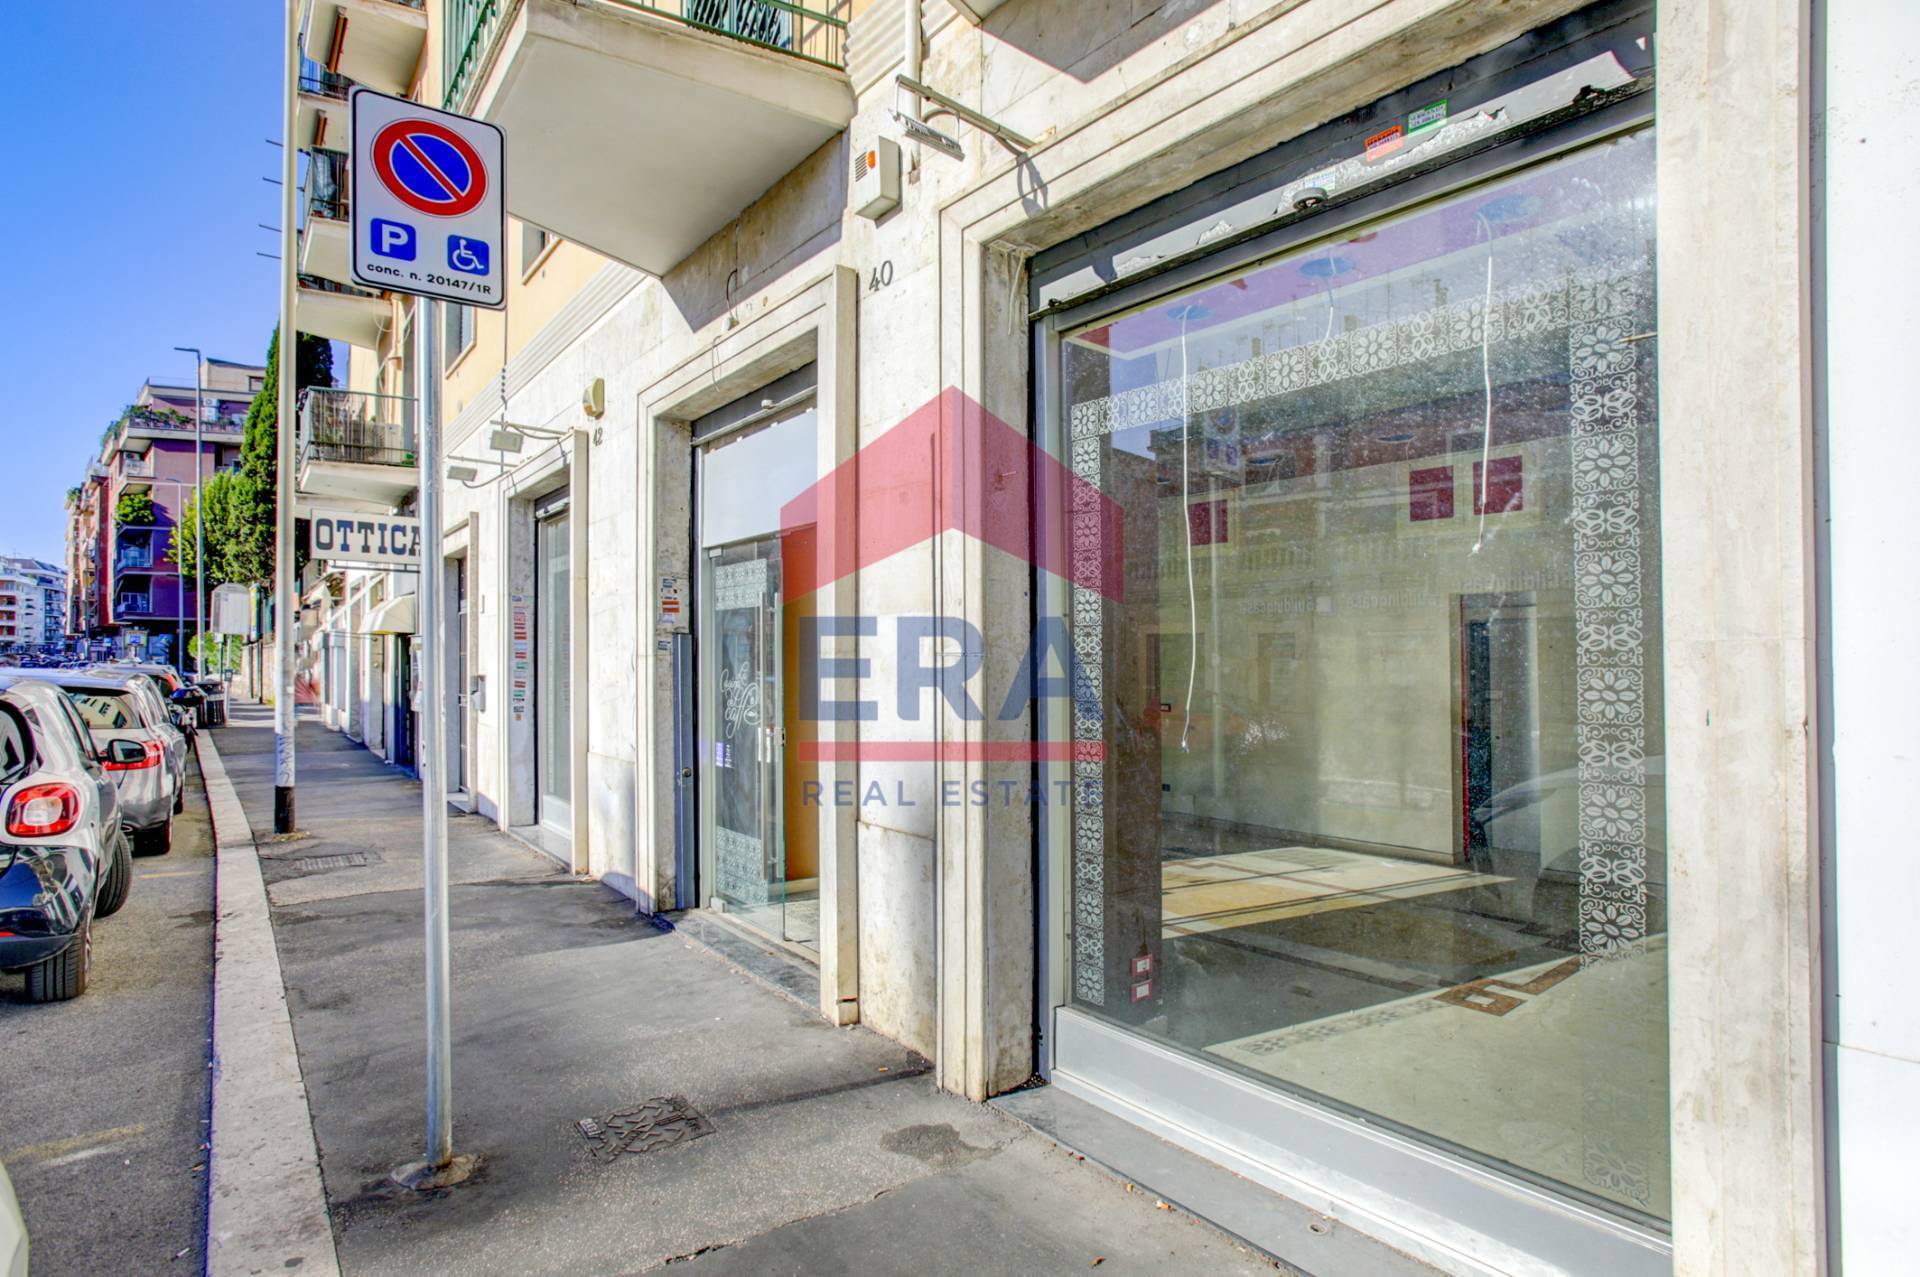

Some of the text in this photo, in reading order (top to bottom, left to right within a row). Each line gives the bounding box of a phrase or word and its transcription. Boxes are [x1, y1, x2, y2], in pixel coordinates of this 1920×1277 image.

[381, 223, 409, 253] P
[367, 263, 492, 294] conc. n. 20147/1R
[869, 260, 894, 292] 40
[592, 426, 603, 446] 42
